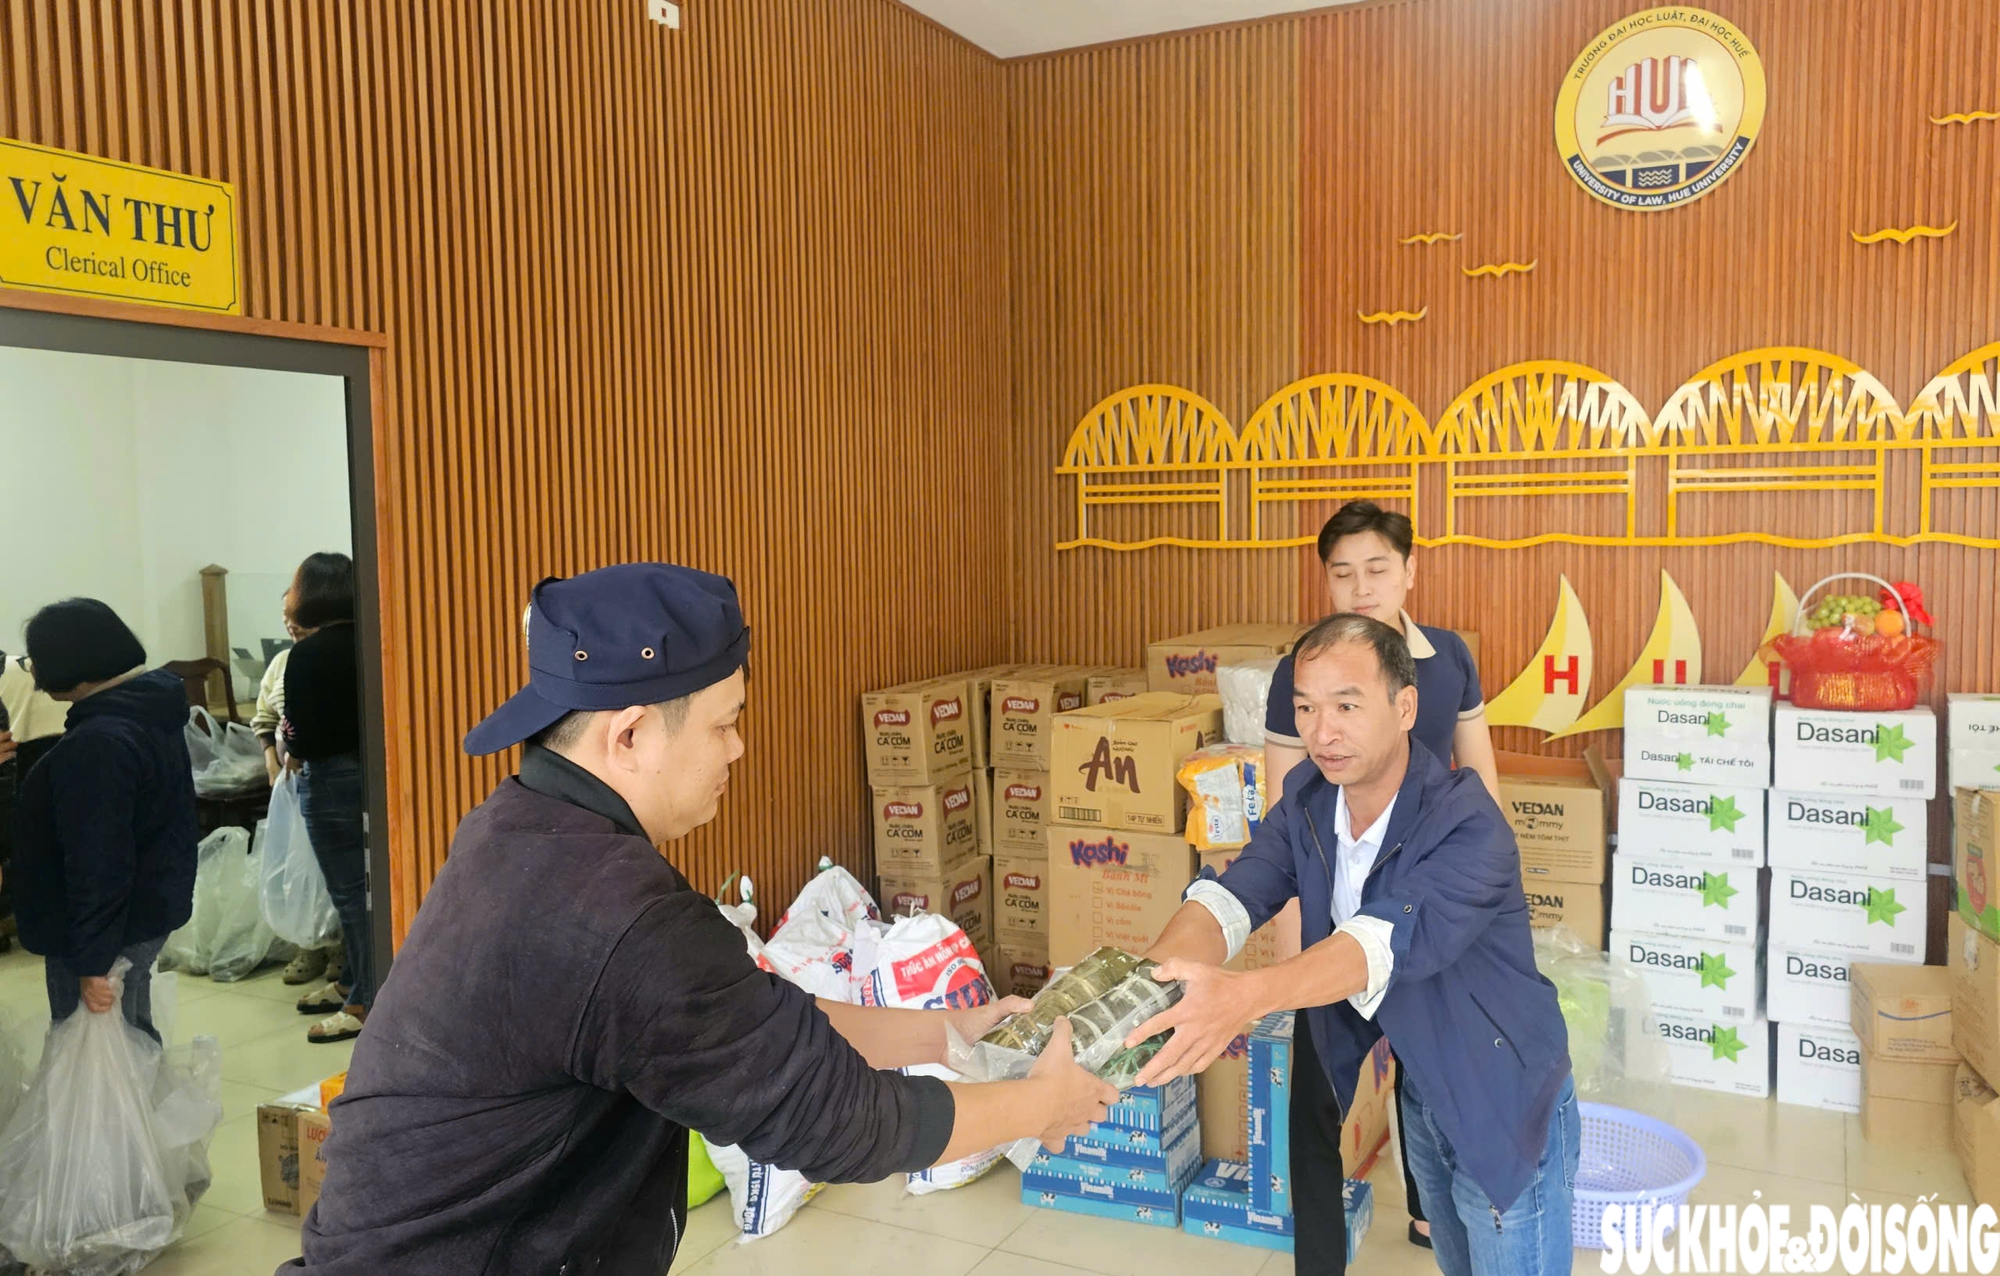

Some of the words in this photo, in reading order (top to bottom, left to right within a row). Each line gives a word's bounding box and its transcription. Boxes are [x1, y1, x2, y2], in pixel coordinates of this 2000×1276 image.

[1608, 55, 1704, 120] HU
[1572, 159, 1620, 201] UNIVERSITY
[1620, 195, 1637, 205] OF
[1668, 188, 1692, 203] HUE
[1692, 142, 1744, 194] UNIVERSITY
[8, 171, 111, 237] VĂN
[124, 197, 215, 252] THƯ
[46, 246, 126, 279] Clerical
[132, 258, 191, 287] Office
[1166, 647, 1218, 679] Kashi
[1657, 709, 1711, 726] Dasani
[1796, 721, 1880, 745] Dasani
[1078, 735, 1141, 794] An
[1640, 750, 1681, 764] Dasani
[1512, 801, 1564, 817] VEDAN
[1638, 791, 1714, 815] Dasani
[1787, 801, 1870, 827] Dasani
[1069, 836, 1129, 868] Kashi
[1632, 866, 1707, 891] Dasani
[1525, 893, 1564, 909] EDAN
[1790, 879, 1872, 907] Dasani
[1629, 944, 1704, 971] Dasani
[1786, 956, 1851, 982] Dasa
